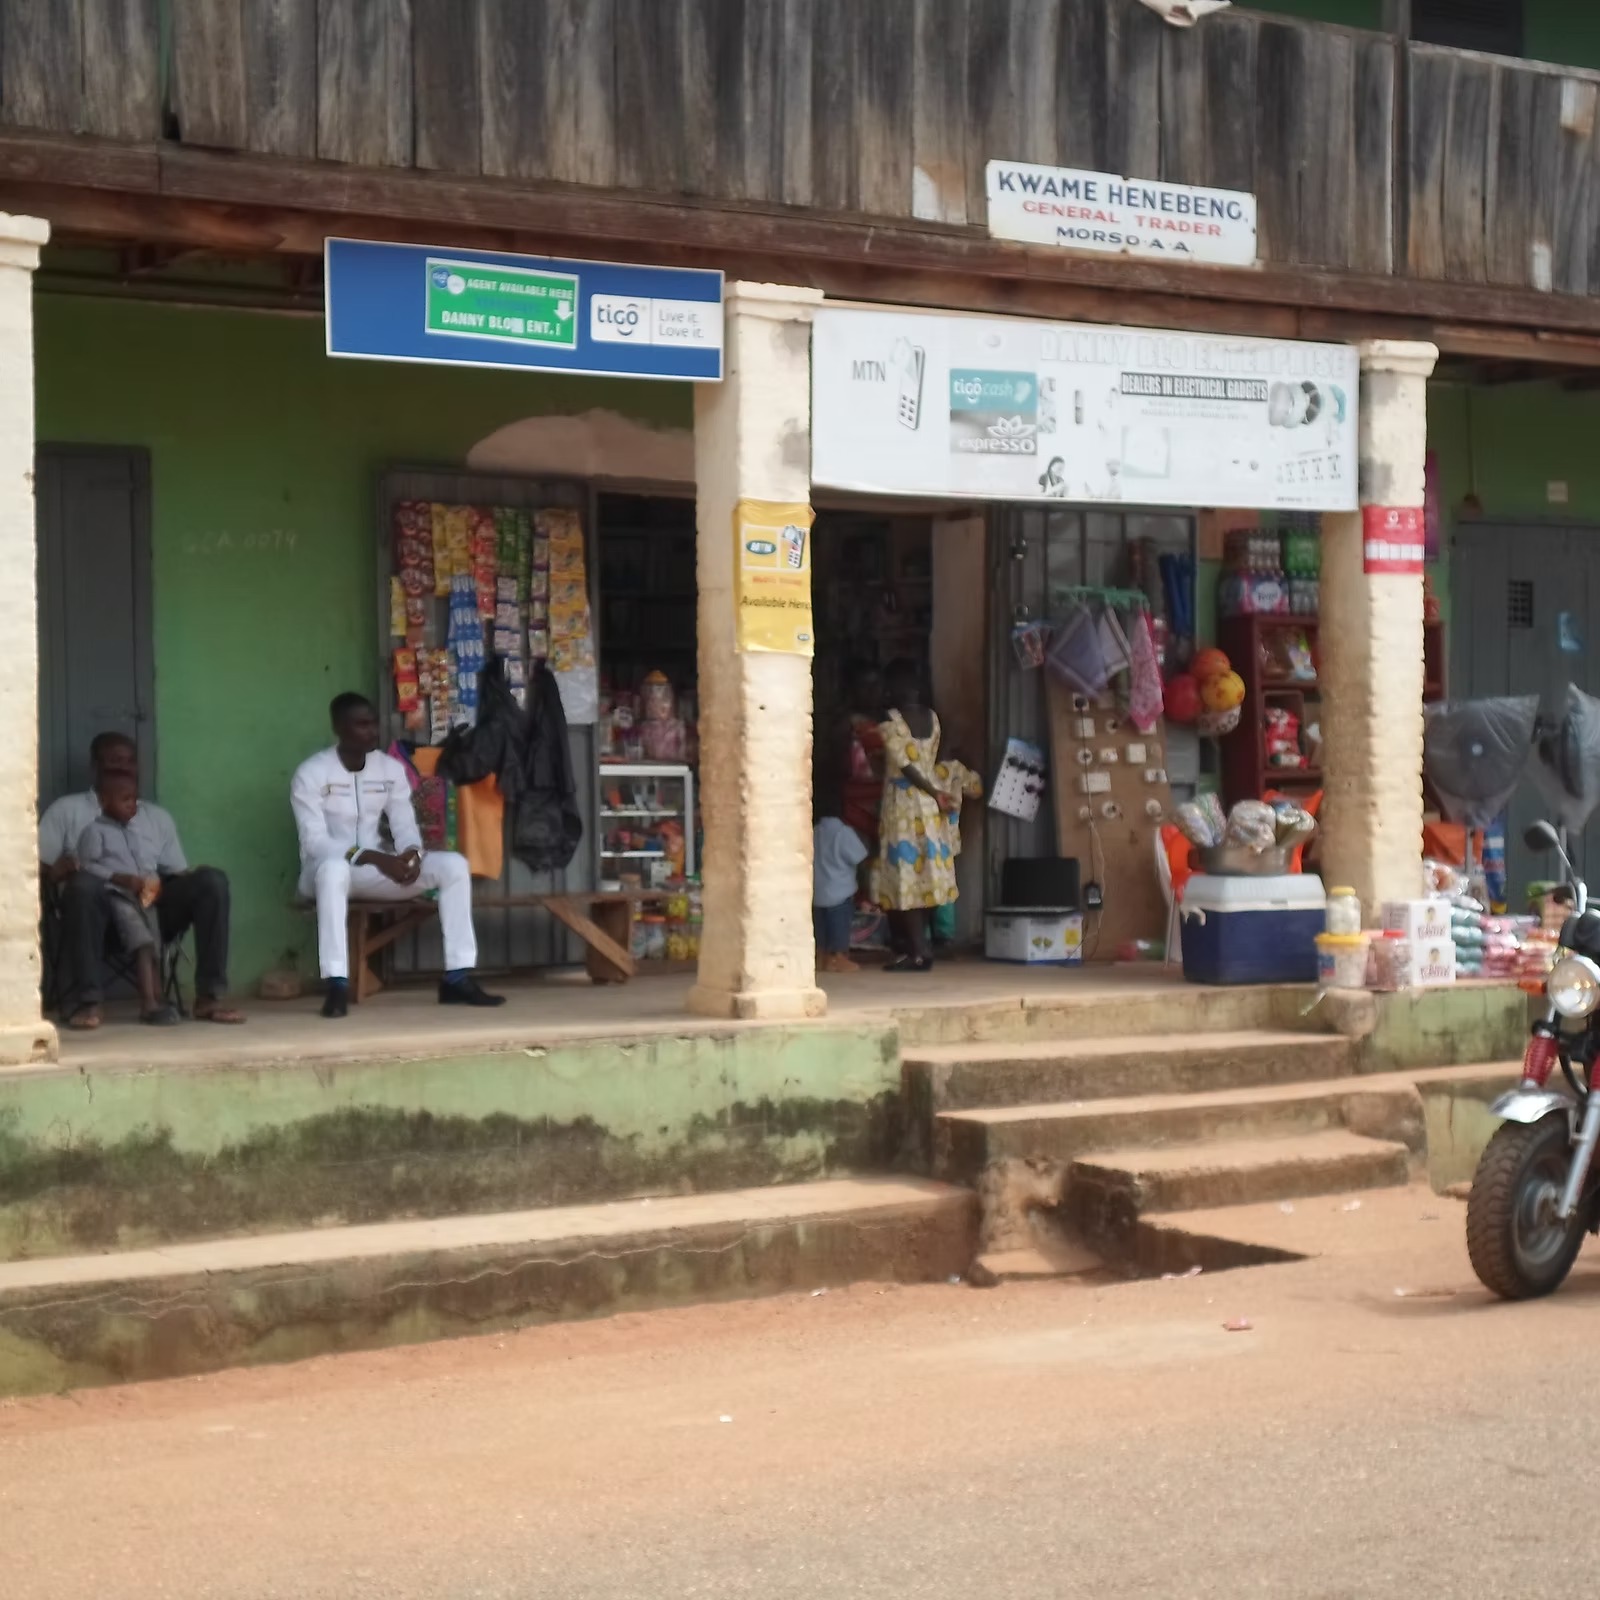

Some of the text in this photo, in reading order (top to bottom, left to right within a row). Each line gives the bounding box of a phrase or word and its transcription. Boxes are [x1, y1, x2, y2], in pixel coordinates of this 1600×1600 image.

[998, 171, 1097, 201] KWAME
[1023, 200, 1222, 237] GENERAL TRADER
[467, 278, 498, 291] AGENT
[499, 282, 547, 297] AVAILABLE
[549, 288, 573, 300] HERE
[441, 310, 485, 328] DANNY
[659, 308, 684, 323] Live
[659, 323, 688, 338] Love
[1040, 329, 1130, 365] DANNY
[852, 360, 886, 382] MTN
[1122, 373, 1268, 400] DEALERS IN ELECTRICAL GADGETS
[959, 437, 1036, 454] expresso
[740, 596, 787, 609] Available
